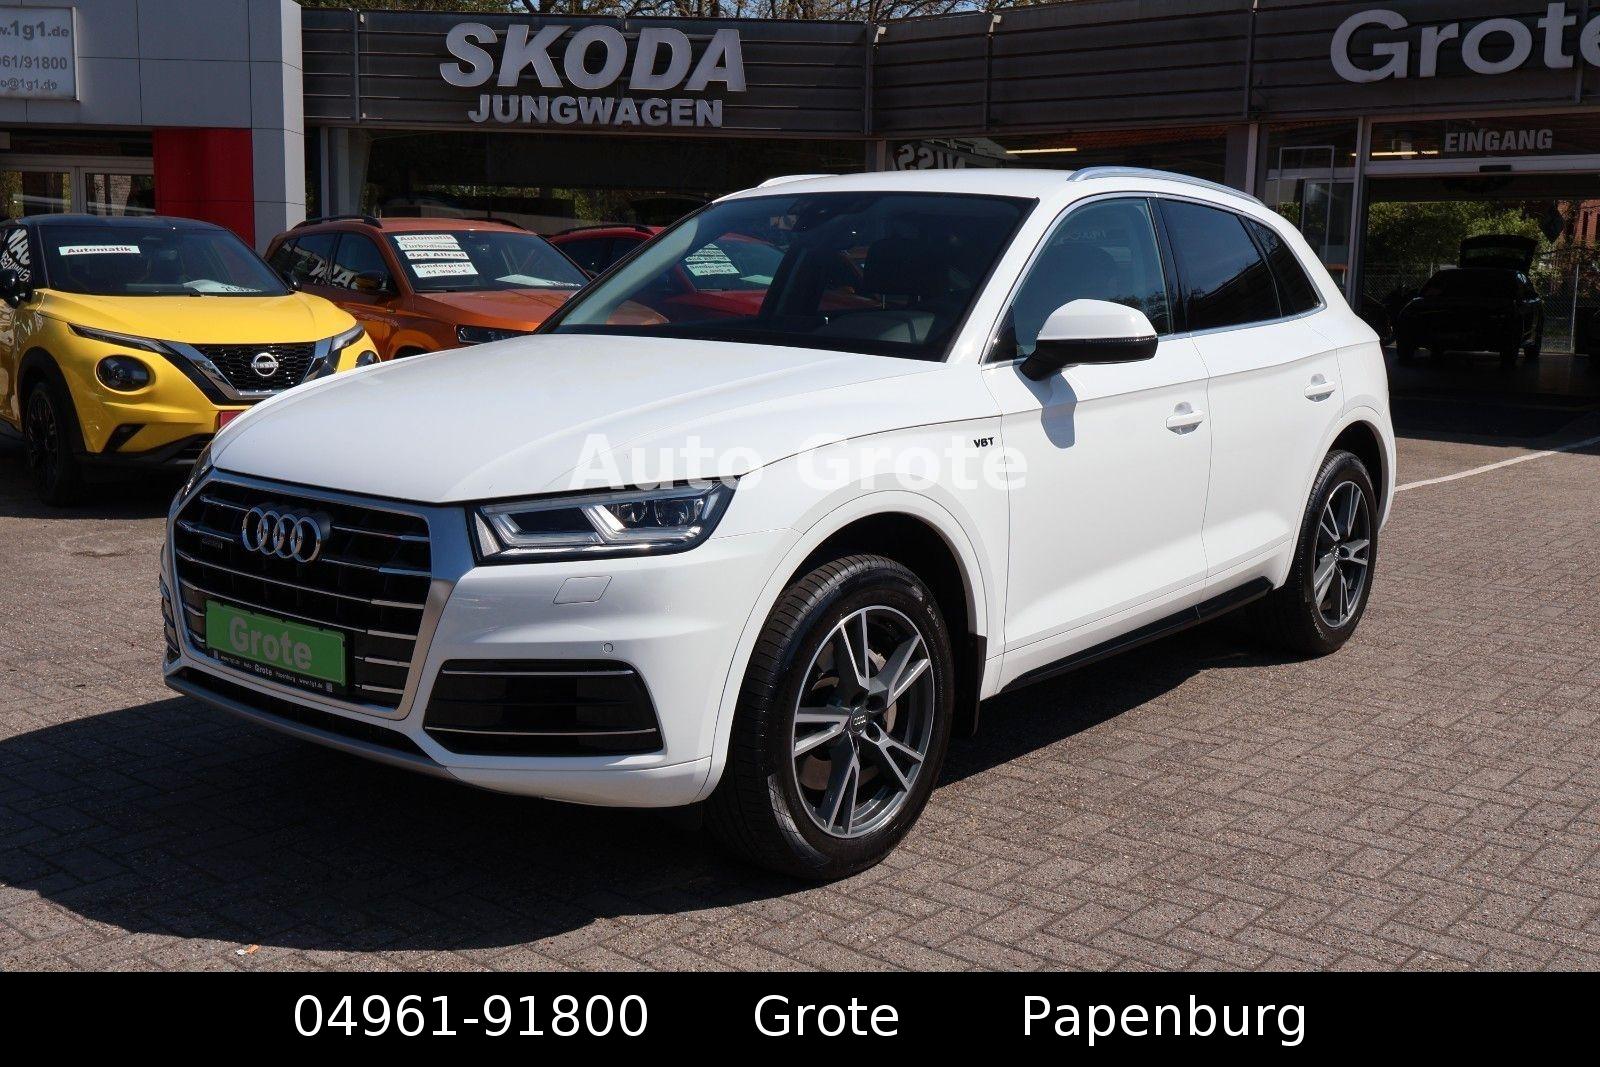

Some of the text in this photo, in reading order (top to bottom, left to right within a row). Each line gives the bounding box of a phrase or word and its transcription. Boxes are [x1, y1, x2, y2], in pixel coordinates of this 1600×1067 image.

[0, 55, 67, 70] 61/91800
[439, 22, 747, 92] SKODA
[468, 94, 723, 128] JUNGWAGEN
[1445, 129, 1553, 152] EINGANG
[66, 246, 132, 254] Automatik
[229, 616, 312, 671] Grote
[254, 663, 273, 677] Grote
